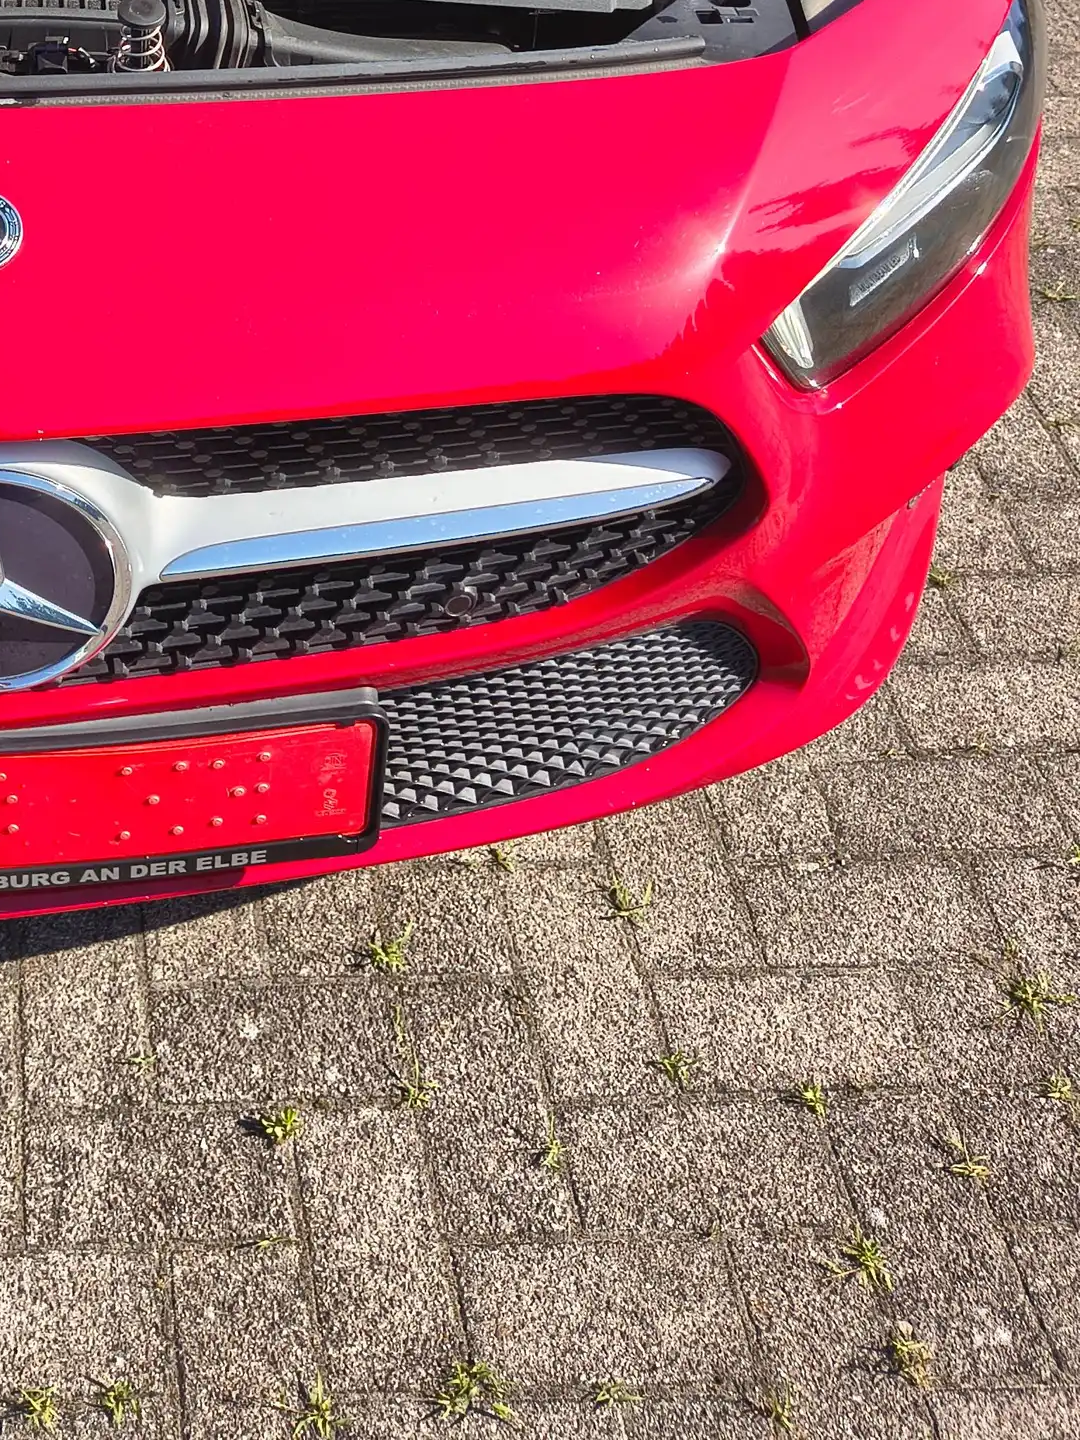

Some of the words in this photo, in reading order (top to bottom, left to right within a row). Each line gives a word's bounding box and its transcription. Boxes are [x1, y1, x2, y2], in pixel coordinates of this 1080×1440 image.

[79, 867, 120, 883] AN
[130, 859, 187, 879] DER
[196, 850, 267, 871] ELBE
